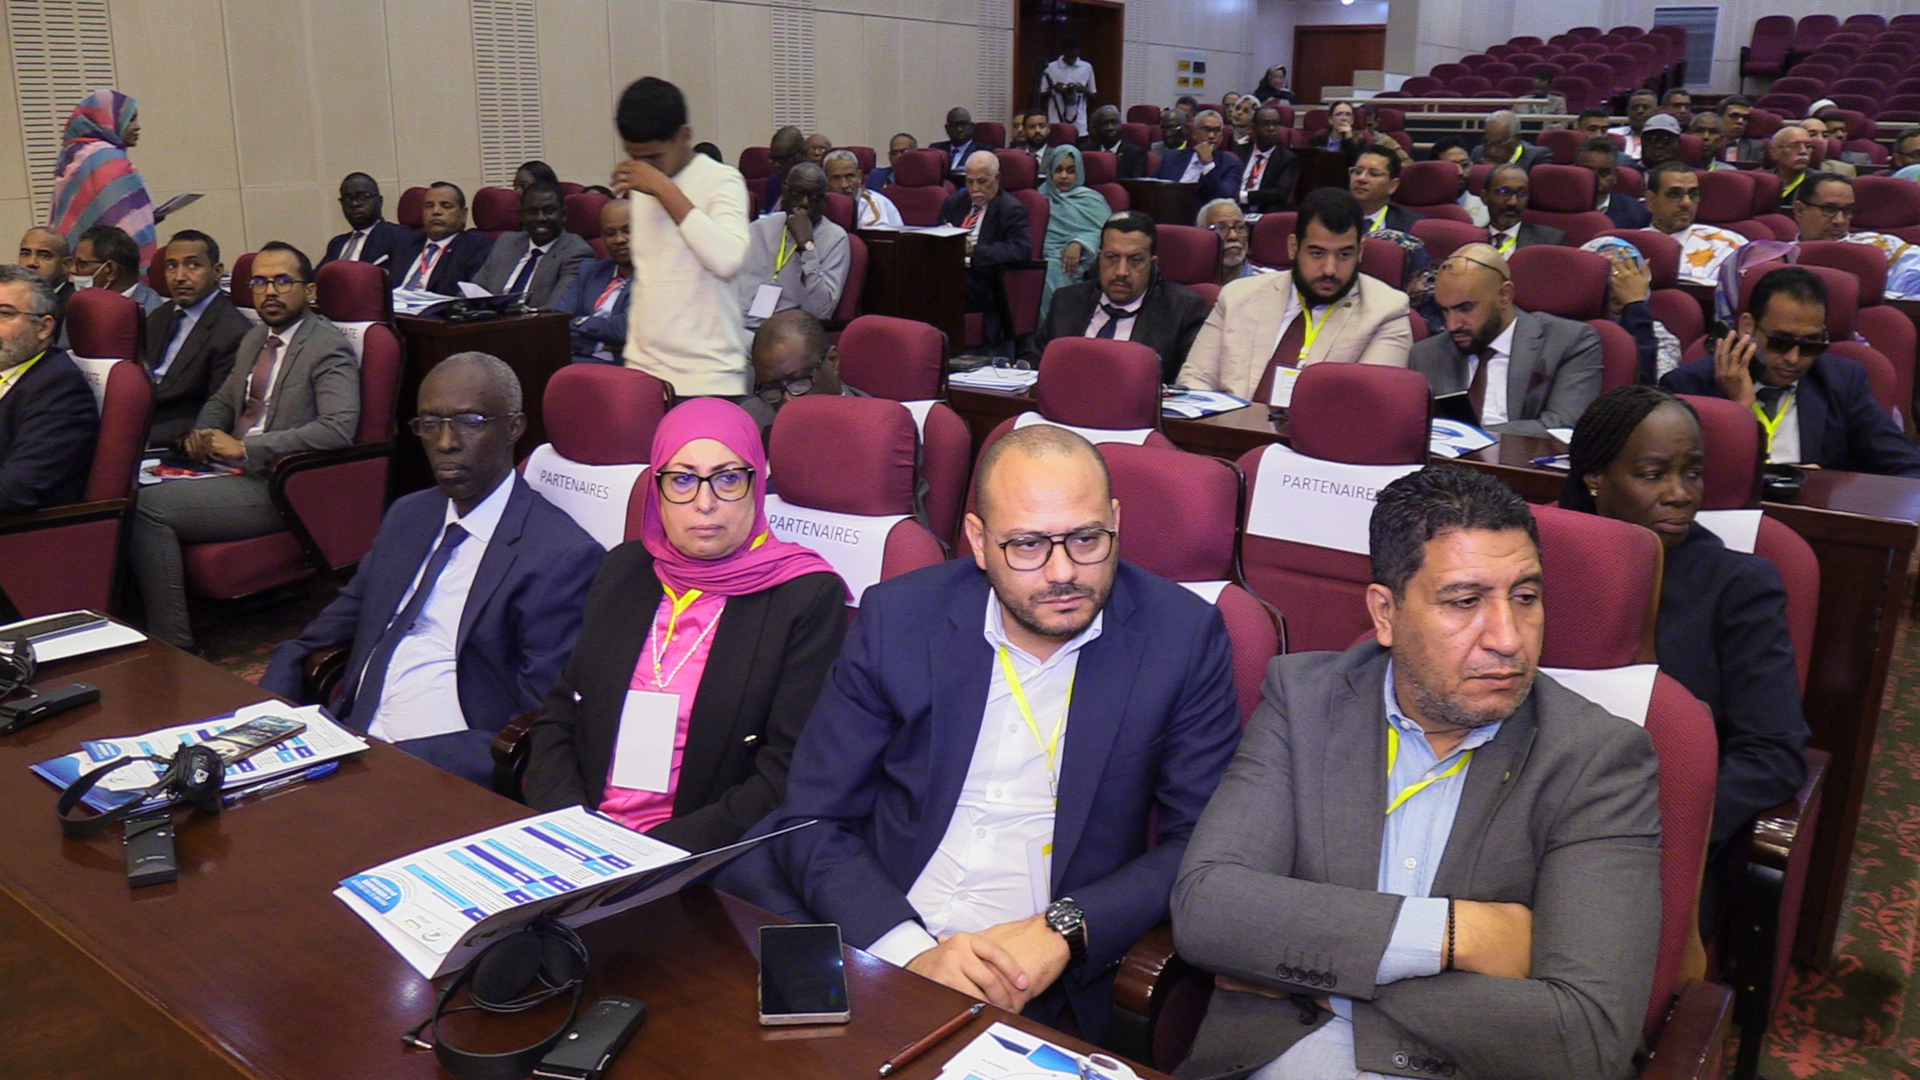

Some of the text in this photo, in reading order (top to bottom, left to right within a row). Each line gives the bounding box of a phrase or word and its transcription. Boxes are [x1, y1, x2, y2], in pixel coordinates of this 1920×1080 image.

[540, 470, 610, 500] PARTENAIRES
[1282, 474, 1382, 502] PARTENAIRE
[769, 514, 861, 545] PARTENAIRES
